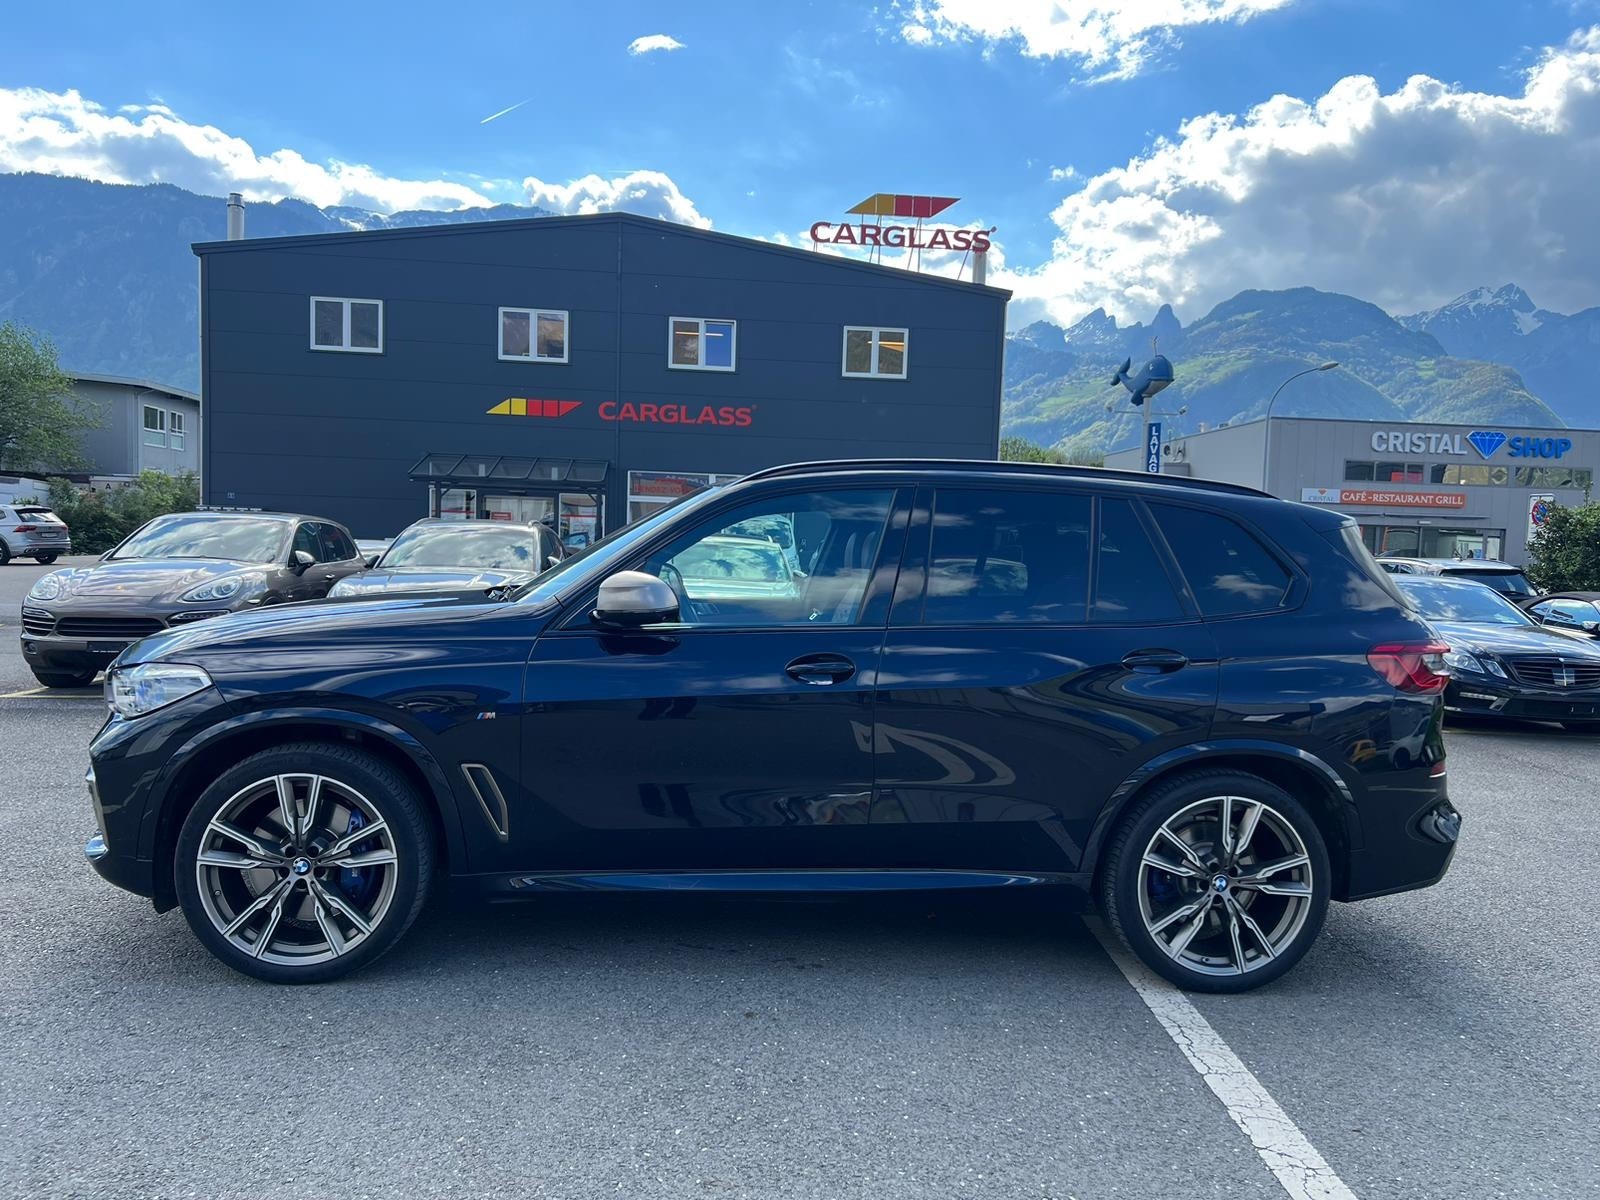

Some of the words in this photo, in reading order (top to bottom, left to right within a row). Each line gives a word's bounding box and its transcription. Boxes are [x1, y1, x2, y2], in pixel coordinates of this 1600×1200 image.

[810, 221, 991, 252] CARGLASS
[598, 401, 752, 427] CARGLASS
[1371, 431, 1468, 455] CRISTAL
[1508, 436, 1572, 460] SHOP
[1435, 495, 1463, 505] GRILL
